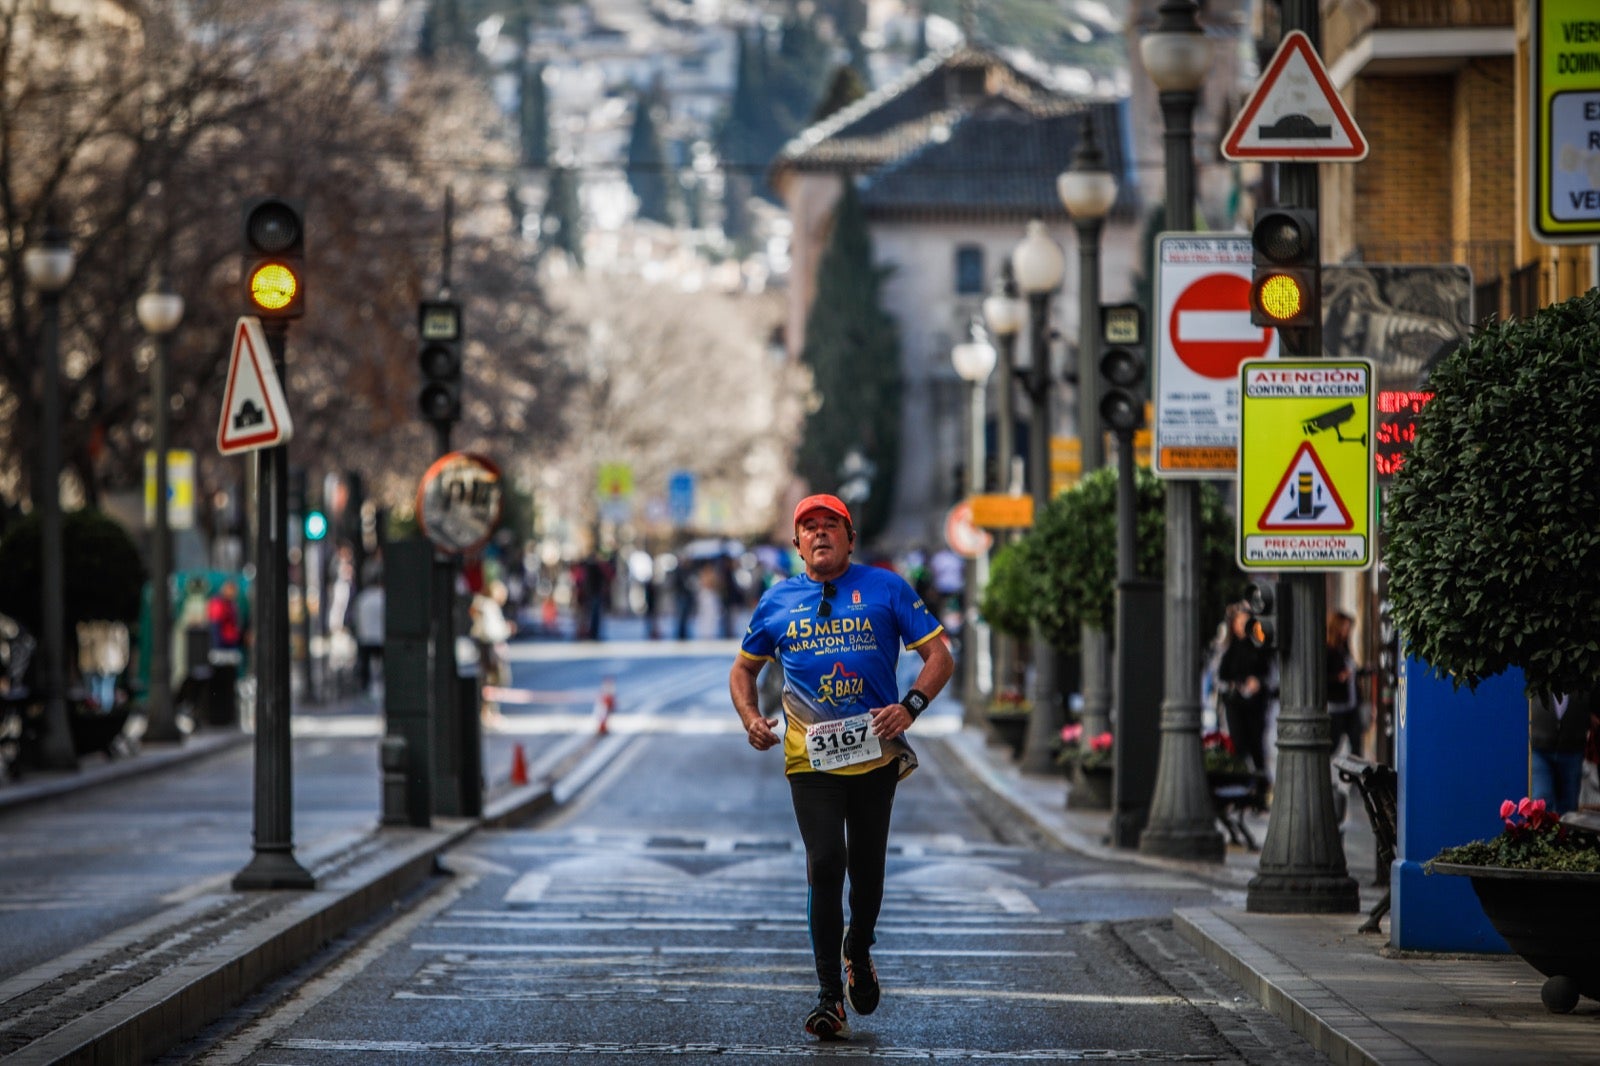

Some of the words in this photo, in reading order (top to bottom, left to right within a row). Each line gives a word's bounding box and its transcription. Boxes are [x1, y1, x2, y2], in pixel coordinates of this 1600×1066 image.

[1255, 368, 1360, 382] ATENCIÓN
[1248, 384, 1295, 395] CONTROL
[1300, 384, 1312, 395] DE
[1316, 384, 1365, 395] ACCESOS
[1264, 536, 1346, 549] PRECAUCIÓN
[1250, 549, 1289, 559] PILONA
[786, 618, 813, 639] 45
[815, 617, 873, 636] MEDIA
[789, 635, 845, 653] MARATON
[849, 633, 876, 645] BAZA
[825, 646, 839, 655] Run
[841, 645, 850, 653] for
[835, 678, 864, 698] BAZA
[811, 725, 869, 752] 3167
